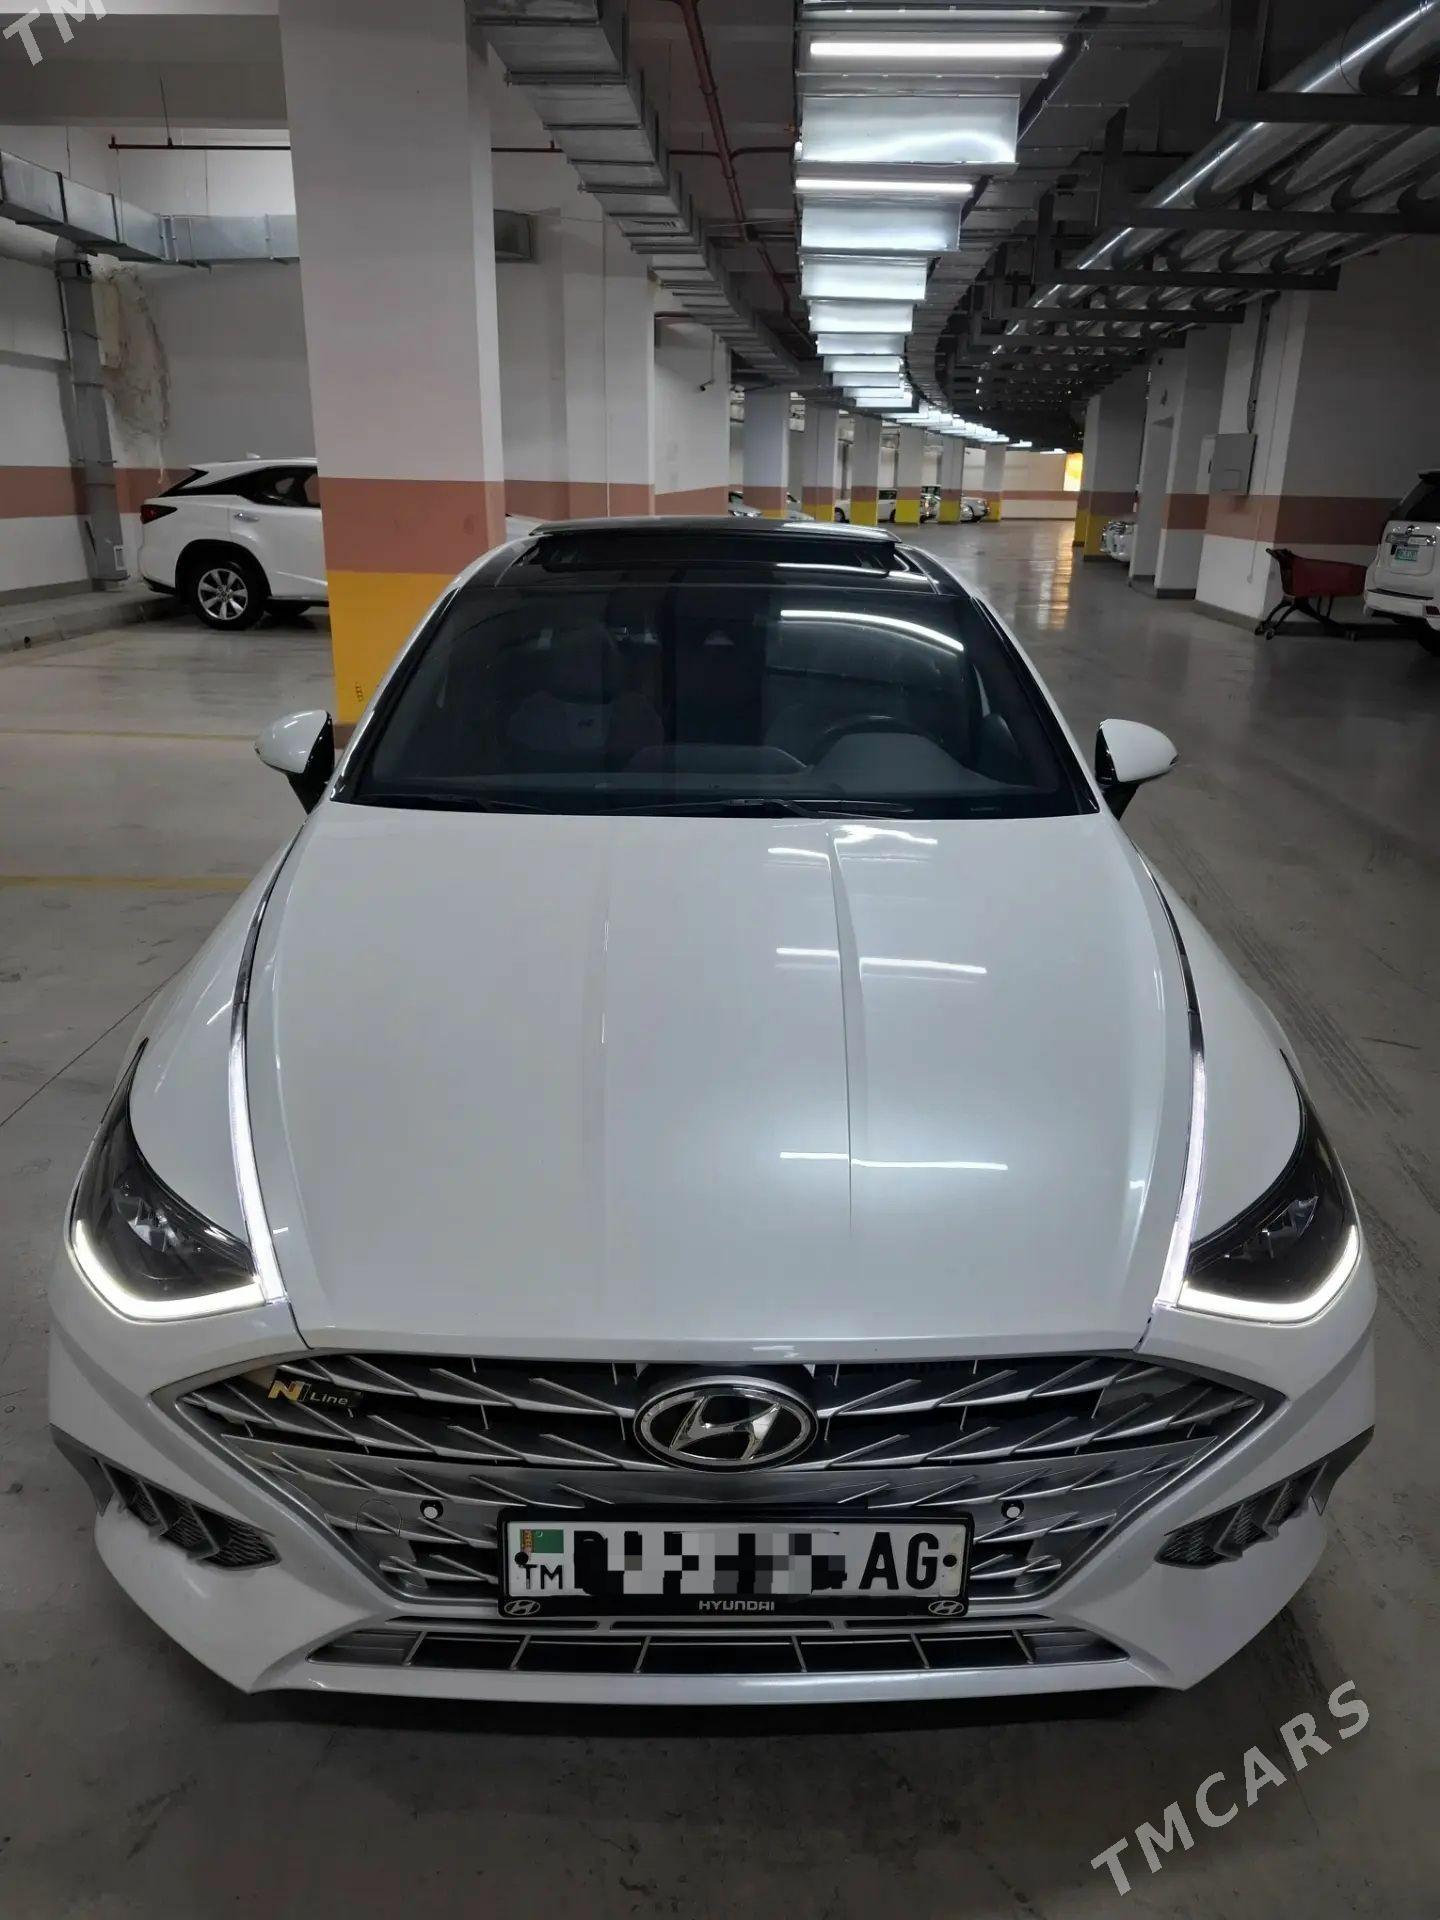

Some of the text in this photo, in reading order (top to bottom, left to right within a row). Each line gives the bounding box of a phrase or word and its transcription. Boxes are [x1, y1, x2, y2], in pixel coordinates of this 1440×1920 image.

[267, 1380, 348, 1405] N Line
[858, 1531, 940, 1591] AG
[519, 1563, 563, 1590] TM
[698, 1600, 775, 1612] HYUNDAI
